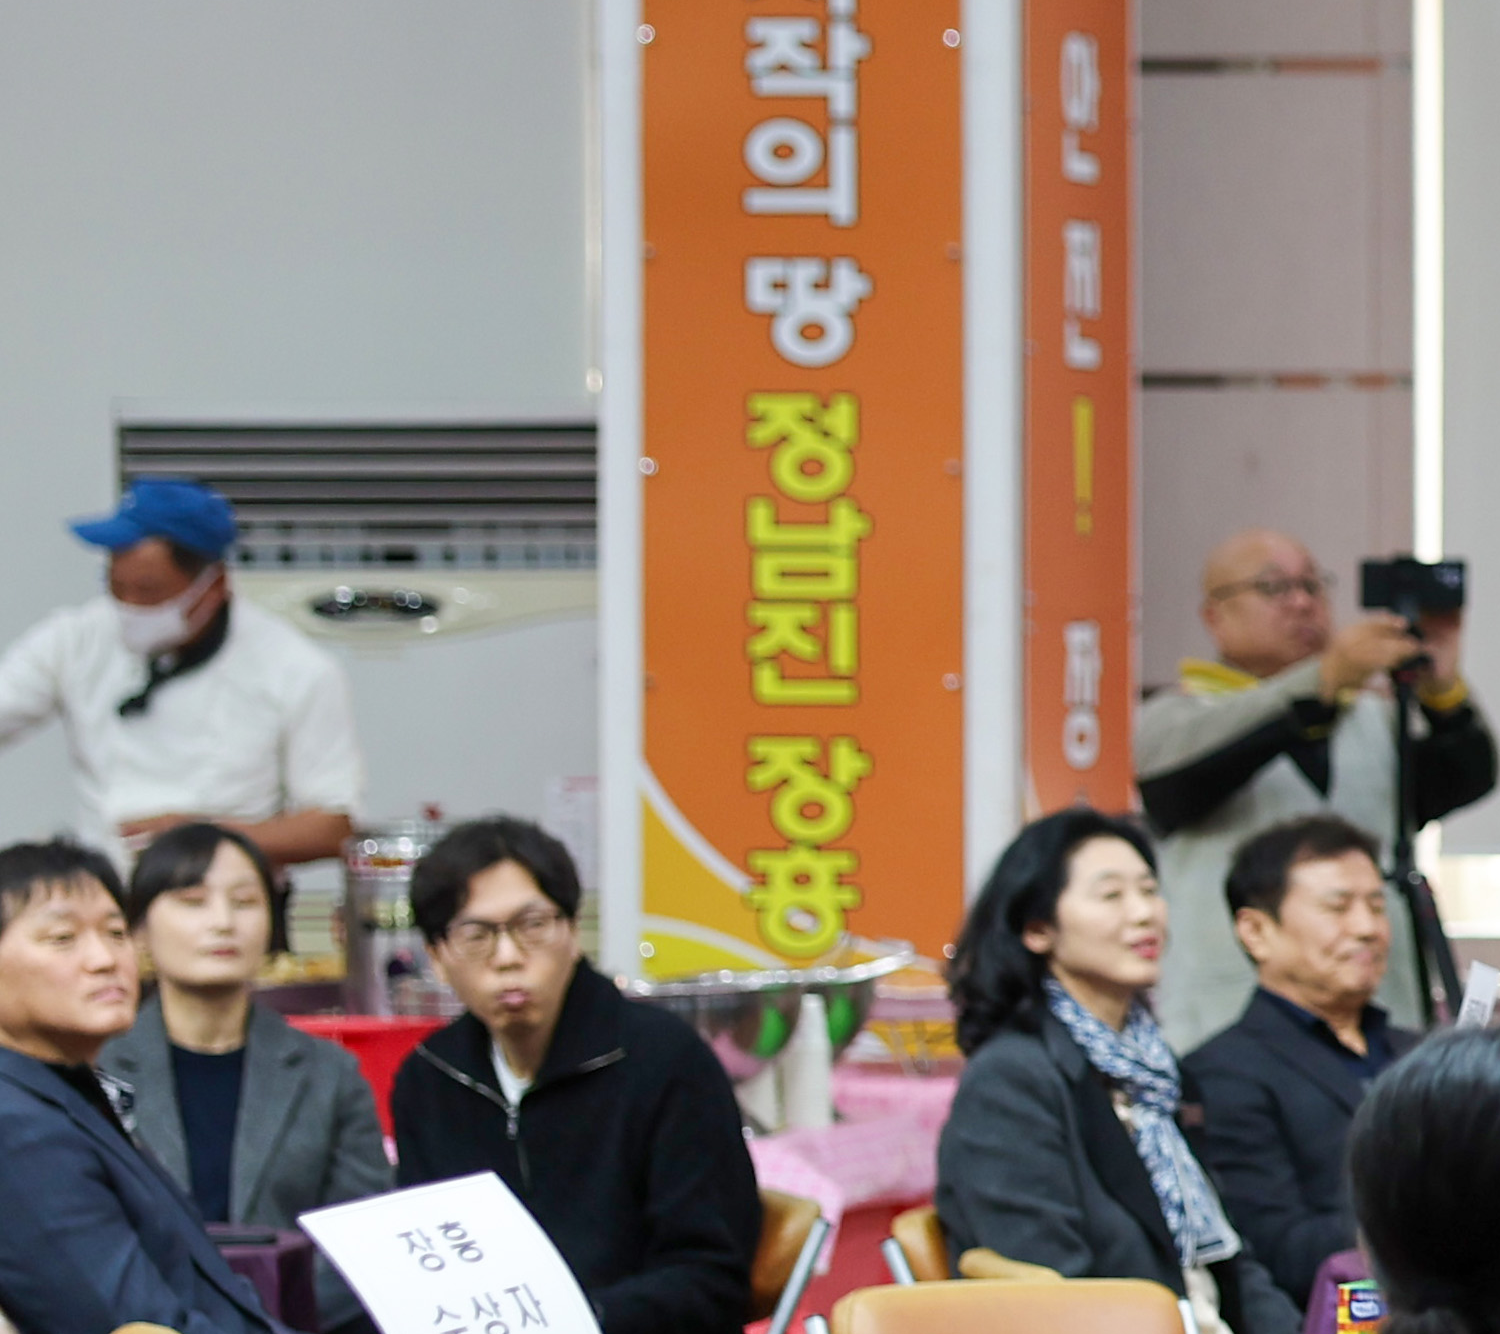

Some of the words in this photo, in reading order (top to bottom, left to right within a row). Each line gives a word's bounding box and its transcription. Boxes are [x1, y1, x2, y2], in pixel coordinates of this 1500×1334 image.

[743, 256, 875, 368] 땅
[744, 389, 875, 706] 정남진
[743, 734, 874, 958] 장흥
[397, 1221, 484, 1272] 장흥
